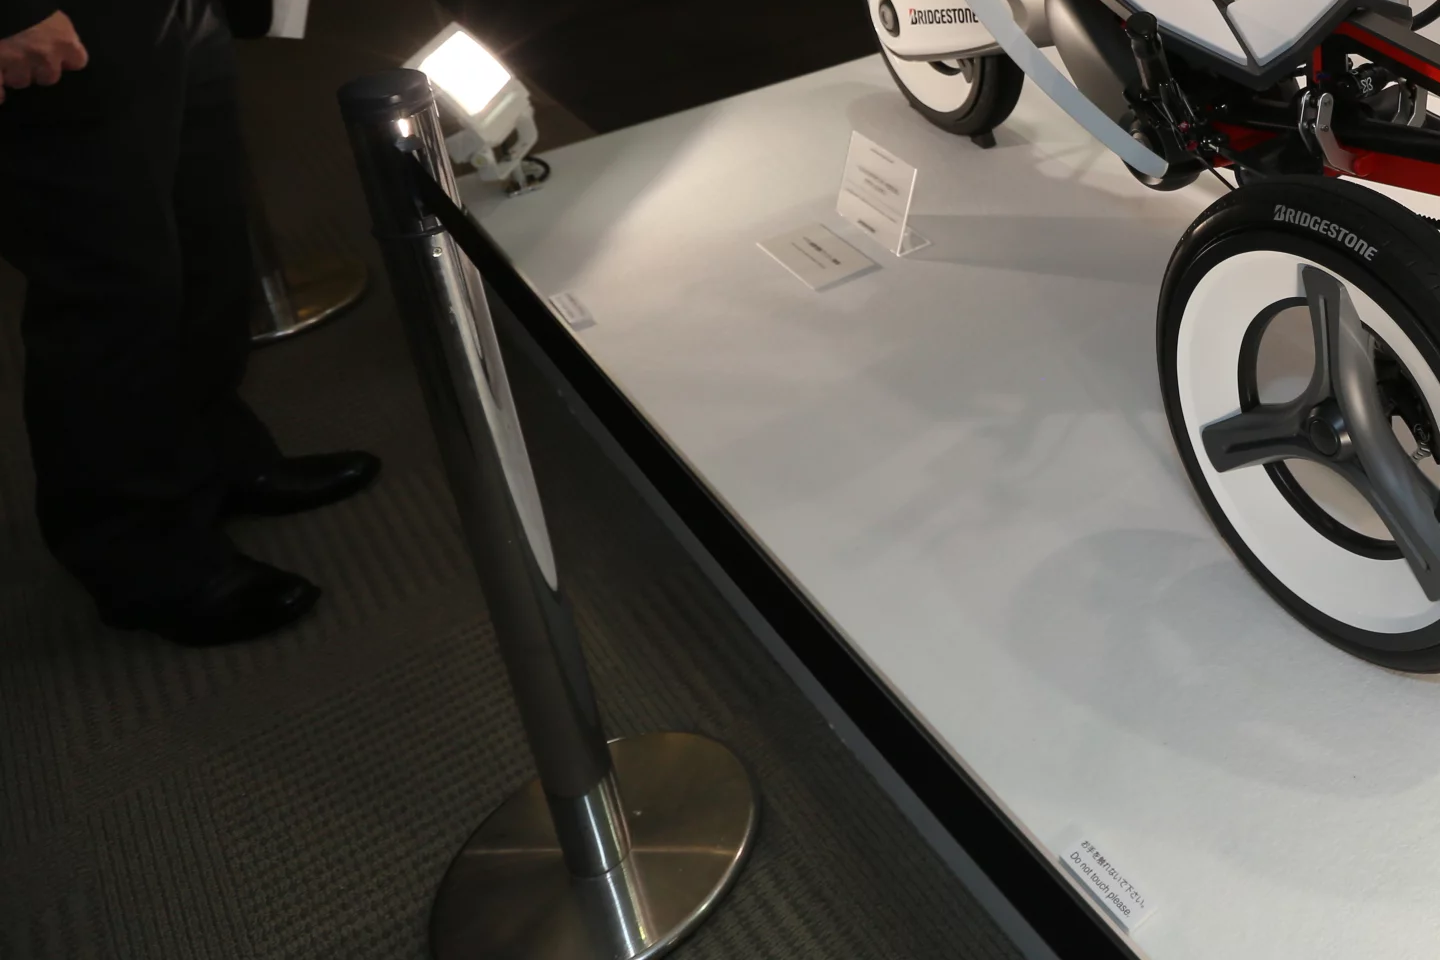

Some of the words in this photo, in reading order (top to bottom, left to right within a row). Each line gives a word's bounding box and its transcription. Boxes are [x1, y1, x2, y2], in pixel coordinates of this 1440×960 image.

[1273, 204, 1378, 261] BRIDGESTONE
[1070, 851, 1081, 864] Do
[1080, 862, 1093, 876] not
[1090, 872, 1110, 894] touch
